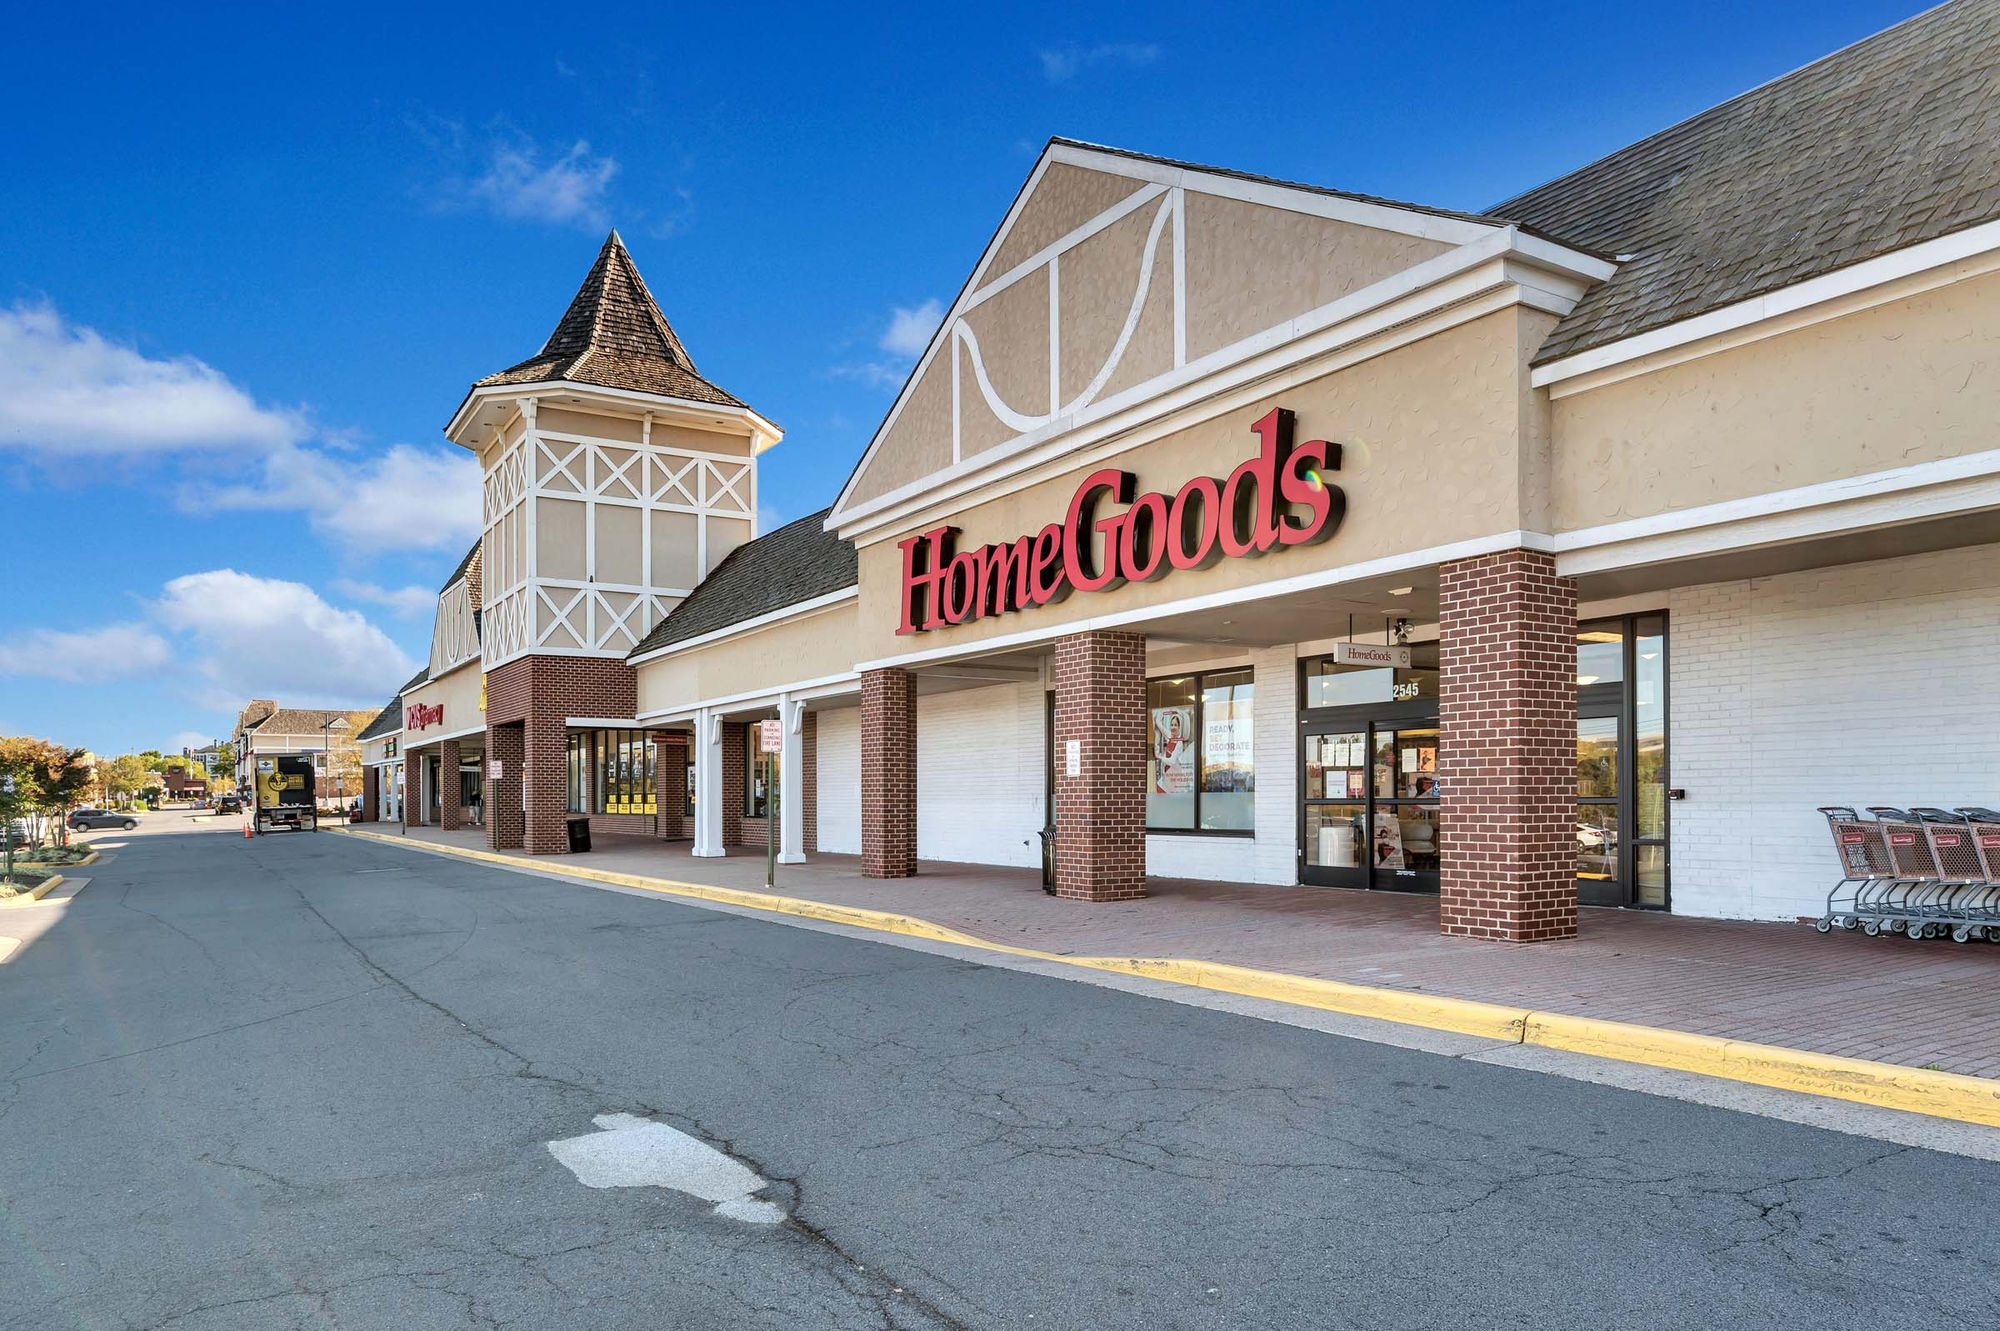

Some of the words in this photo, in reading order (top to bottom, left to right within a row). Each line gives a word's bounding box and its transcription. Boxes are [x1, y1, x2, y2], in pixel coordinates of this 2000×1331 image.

[895, 407, 1346, 637] HomeGoods
[1348, 647, 1391, 661] HomeGoods
[1393, 683, 1419, 698] 2545
